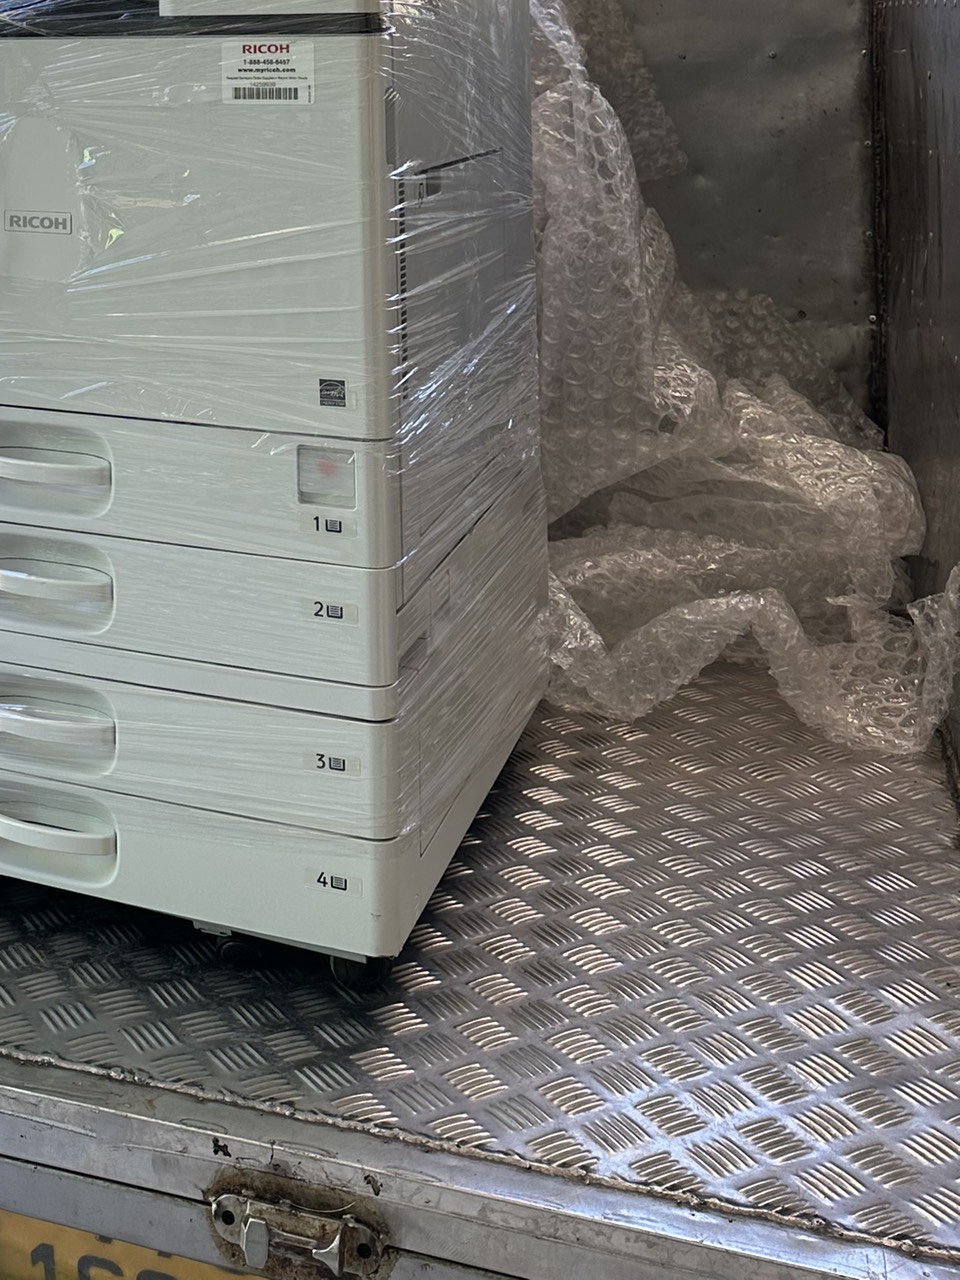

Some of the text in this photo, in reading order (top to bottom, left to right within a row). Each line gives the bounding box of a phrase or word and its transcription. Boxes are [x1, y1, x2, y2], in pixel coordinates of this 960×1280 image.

[242, 44, 290, 54] RICOH
[9, 214, 67, 230] RICOH
[313, 516, 320, 532] 1
[313, 601, 324, 618] 2
[316, 753, 326, 770] 3
[316, 871, 328, 888] 4
